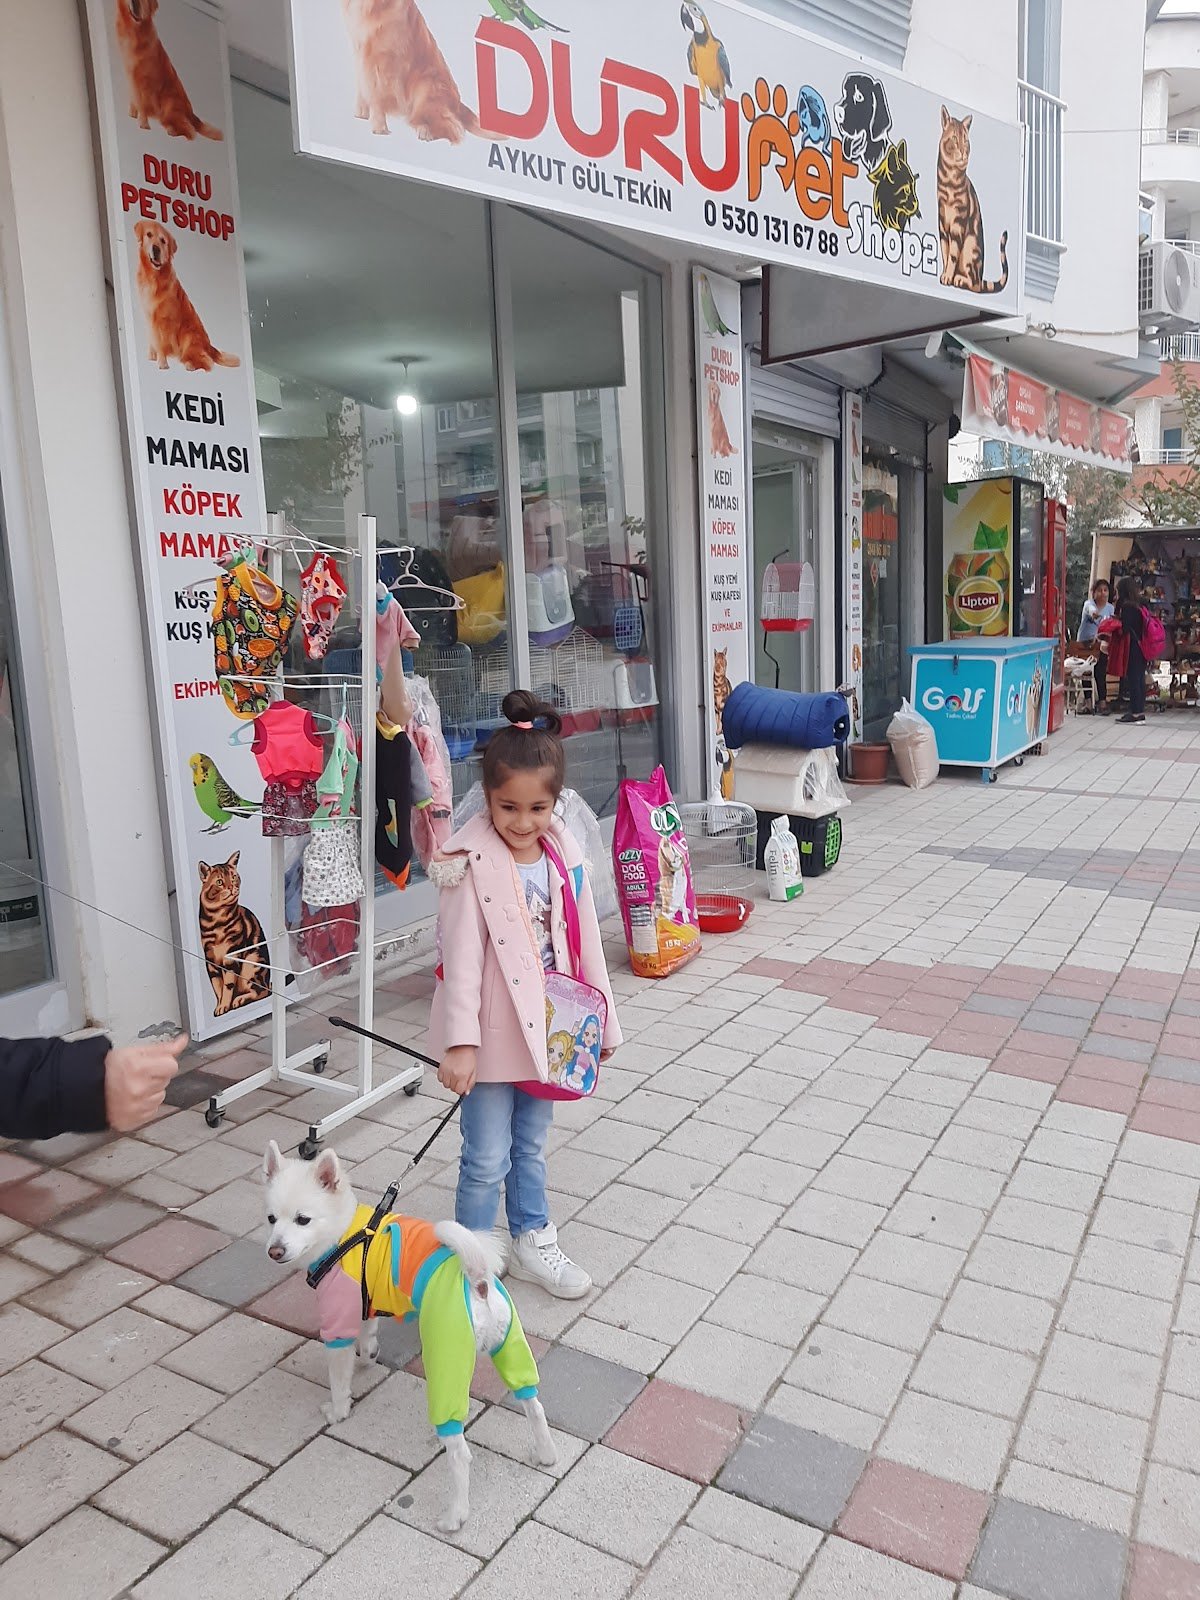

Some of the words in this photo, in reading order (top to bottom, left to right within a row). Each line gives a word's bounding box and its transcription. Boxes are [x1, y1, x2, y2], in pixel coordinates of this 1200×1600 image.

[474, 15, 740, 192] DURU
[142, 153, 212, 201] DURU
[487, 142, 567, 185] AYKUT
[571, 160, 673, 212] GÜLTEKİN
[121, 182, 235, 241] PETSHOP
[704, 199, 717, 227] 0
[722, 203, 759, 237] 530
[763, 214, 789, 245] 131
[793, 223, 814, 250] 67
[818, 229, 839, 257] 88
[711, 345, 732, 367] DURU
[703, 362, 740, 387] PETSHOP
[165, 390, 225, 426] KEDİ
[146, 435, 250, 474] MAMASI
[714, 468, 733, 487] KEDİ
[163, 483, 243, 519] KÖPEK
[708, 493, 739, 511] MAMASI
[712, 518, 736, 536] KÖPEK
[710, 543, 739, 558] MAMASI
[713, 574, 725, 586] KUŞ
[725, 573, 738, 585] YEMİ
[174, 590, 211, 613] KUŞ
[710, 591, 722, 604] KUŞ
[722, 589, 742, 601] KAFESİ
[961, 595, 996, 609] Lipton
[724, 608, 731, 618] VE
[166, 621, 203, 645] KUŞ
[712, 621, 743, 633] EKİPMANLARI
[922, 687, 987, 713] Golf
[621, 862, 645, 874] DOG
[623, 871, 646, 881] FOOD
[626, 883, 646, 892] ADULT
